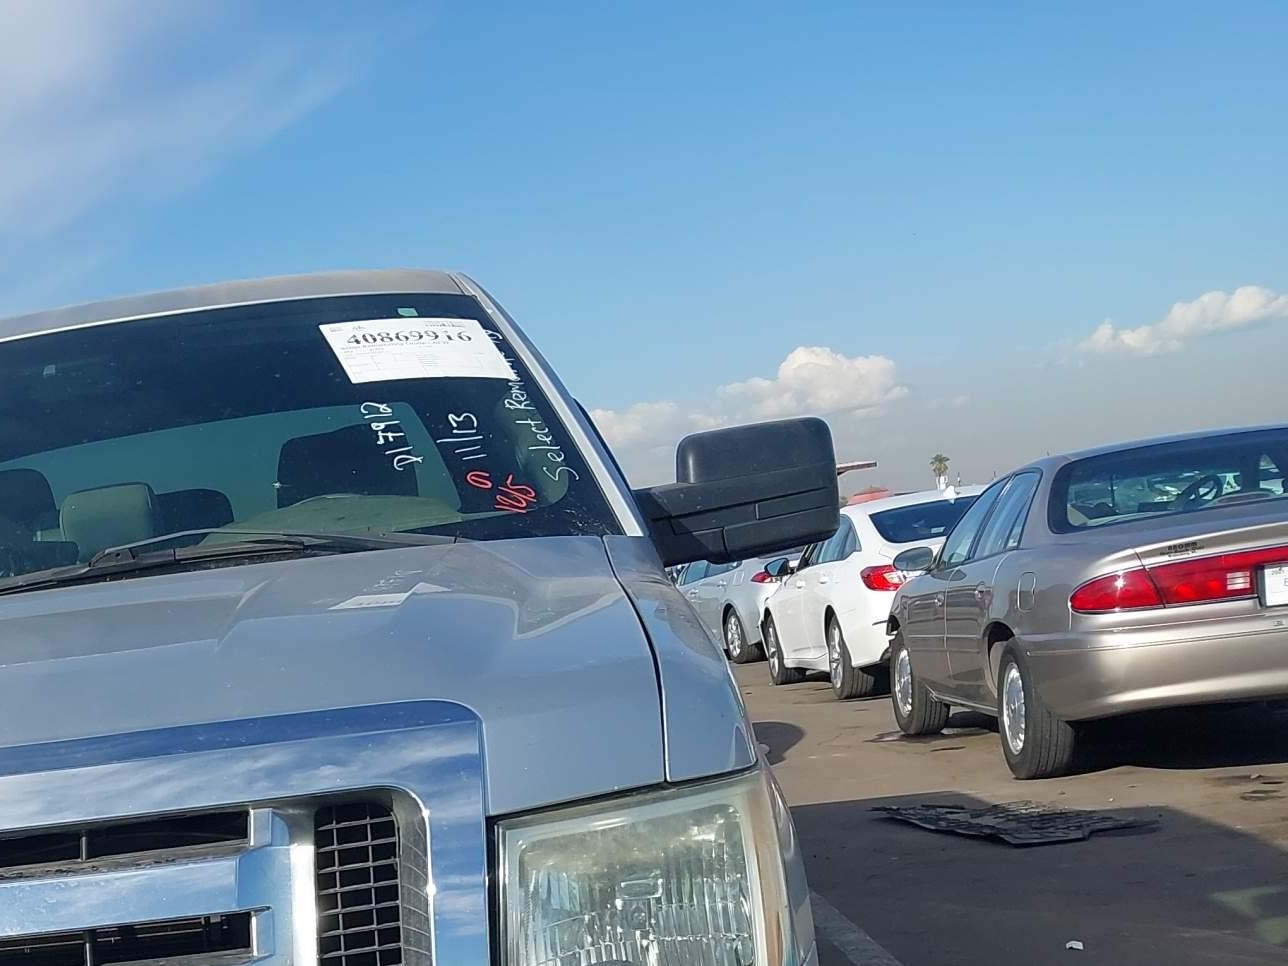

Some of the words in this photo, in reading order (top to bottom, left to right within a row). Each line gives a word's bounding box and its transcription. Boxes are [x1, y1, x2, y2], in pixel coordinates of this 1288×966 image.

[346, 329, 473, 345] 40869916
[436, 413, 488, 460] 11/13
[515, 418, 581, 481] Select
